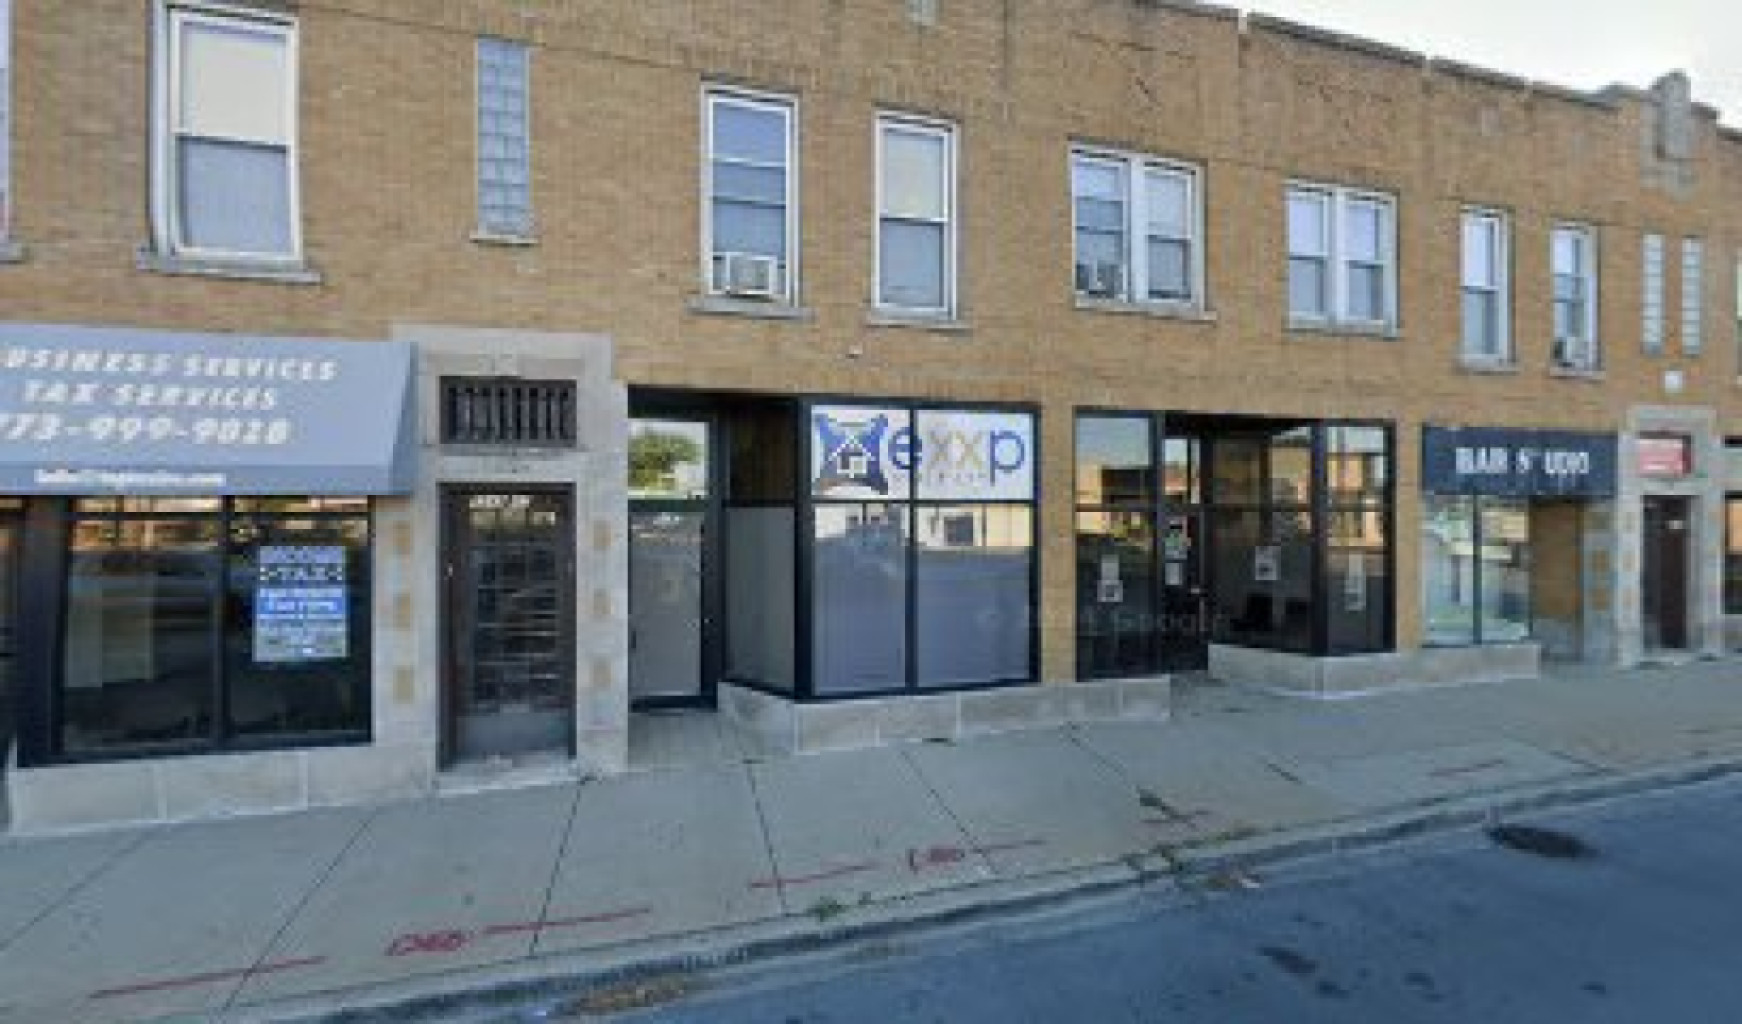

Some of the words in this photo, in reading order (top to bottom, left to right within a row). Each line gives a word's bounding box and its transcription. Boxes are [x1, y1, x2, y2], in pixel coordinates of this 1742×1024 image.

[0, 346, 172, 376] USINESS
[183, 353, 339, 381] SERVICES
[25, 379, 99, 405] TAX
[113, 383, 276, 411] SERVICES
